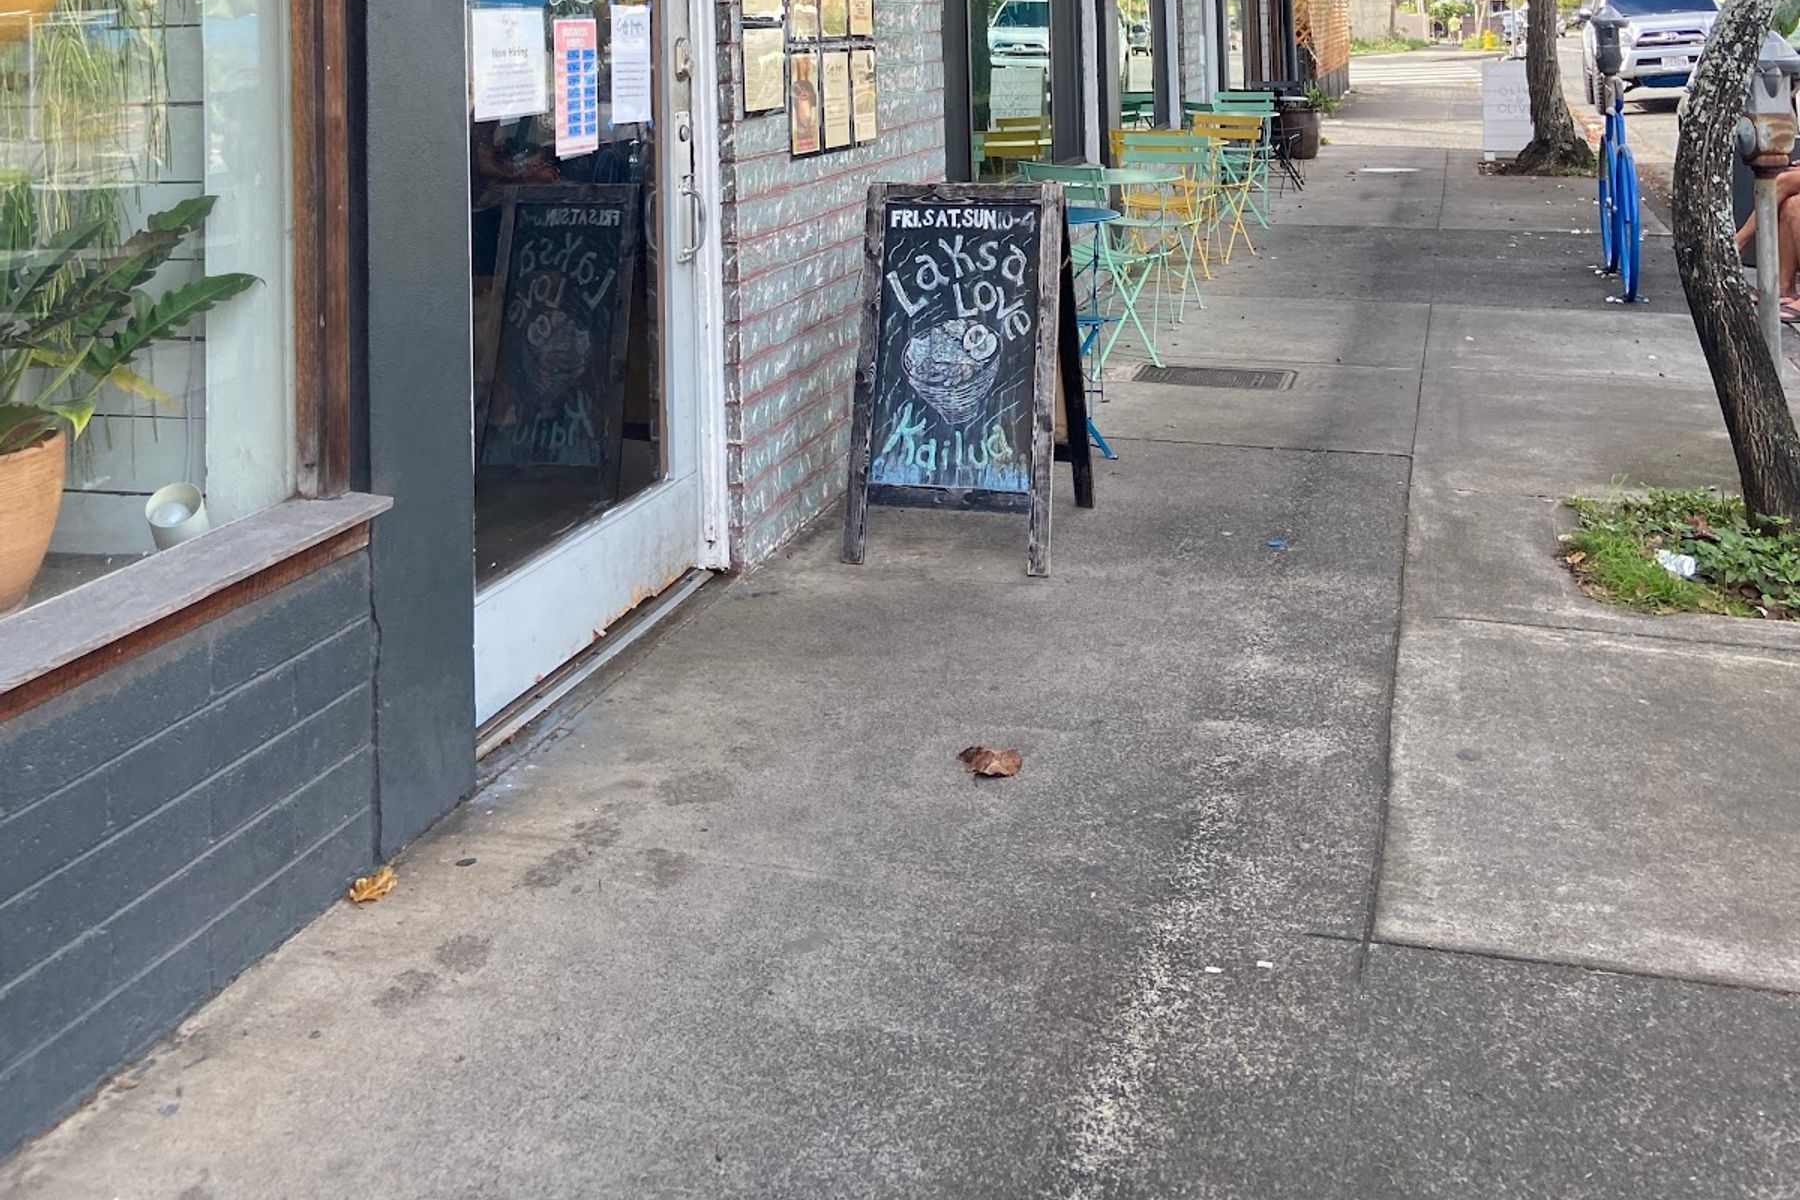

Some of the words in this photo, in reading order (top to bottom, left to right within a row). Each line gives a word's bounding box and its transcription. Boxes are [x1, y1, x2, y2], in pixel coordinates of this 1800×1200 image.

[1499, 85, 1529, 97] OLIV
[1498, 103, 1531, 114] OLIV
[881, 402, 1014, 471] Kailua
